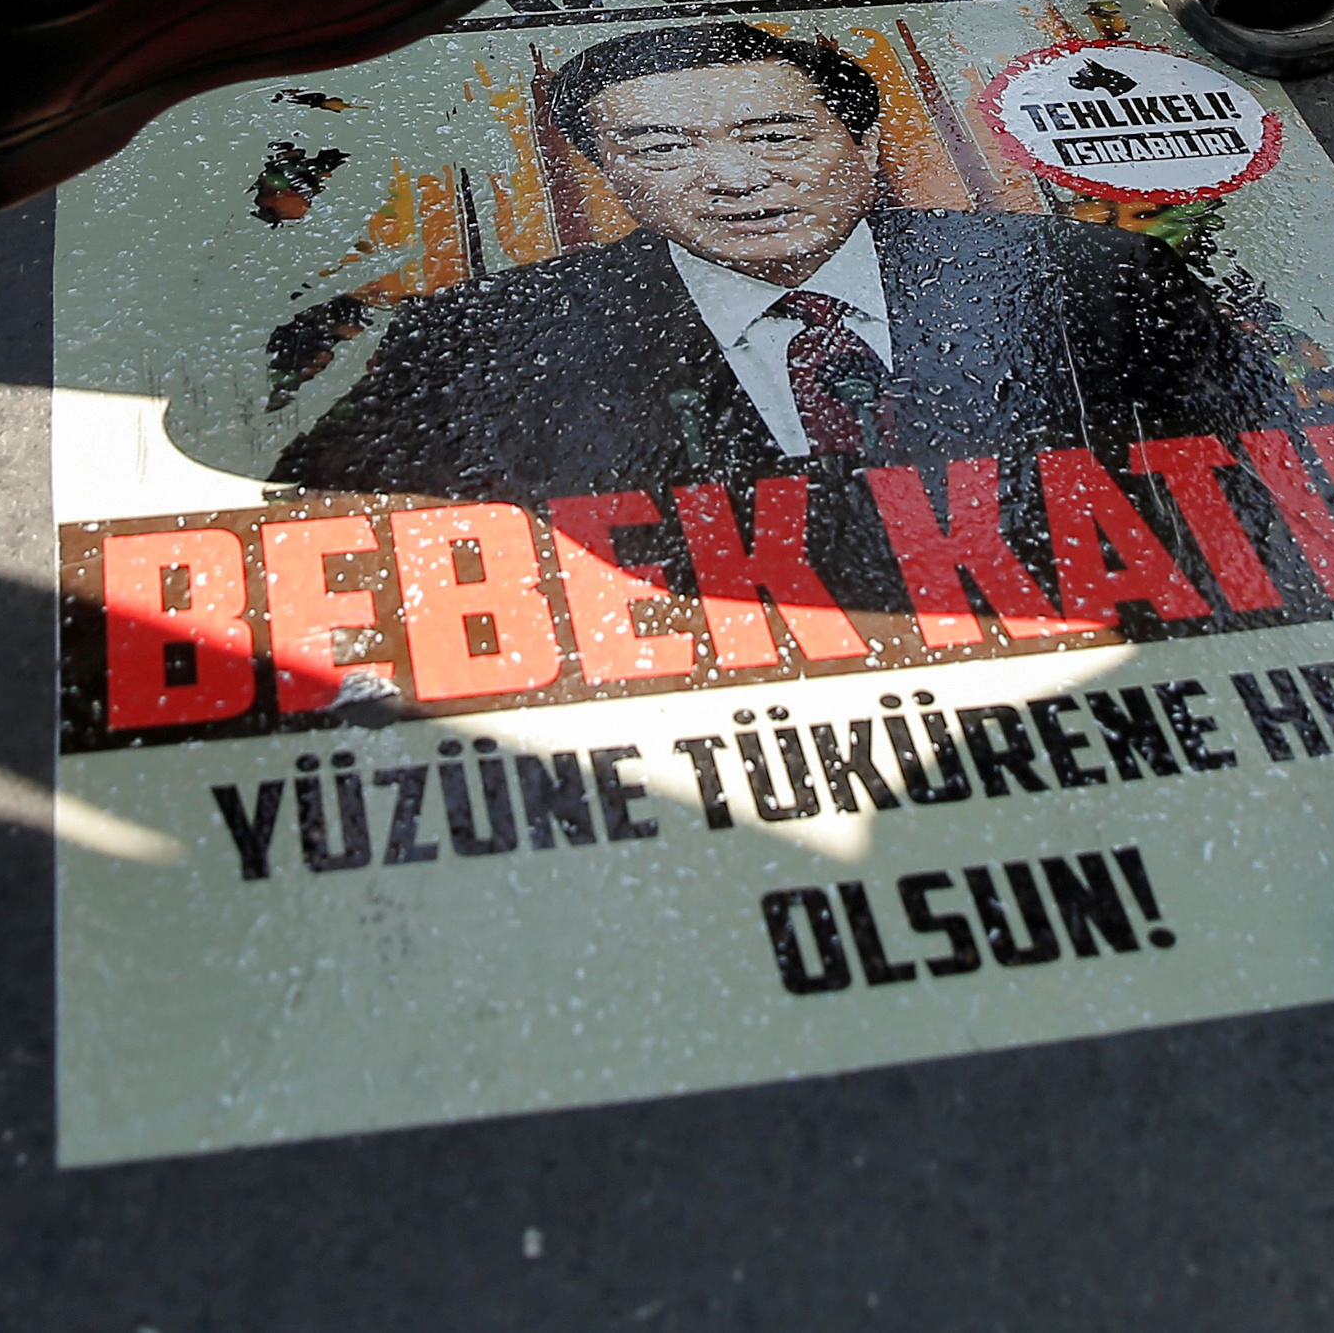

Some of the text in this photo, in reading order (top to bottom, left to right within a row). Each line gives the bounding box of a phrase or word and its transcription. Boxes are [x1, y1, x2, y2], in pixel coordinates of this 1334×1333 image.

[103, 475, 868, 731] BEBEK
[210, 737, 660, 882] YÜZÜNE
[673, 678, 1237, 830] TÜKÜRENE
[760, 846, 1178, 996] OLSUN!
